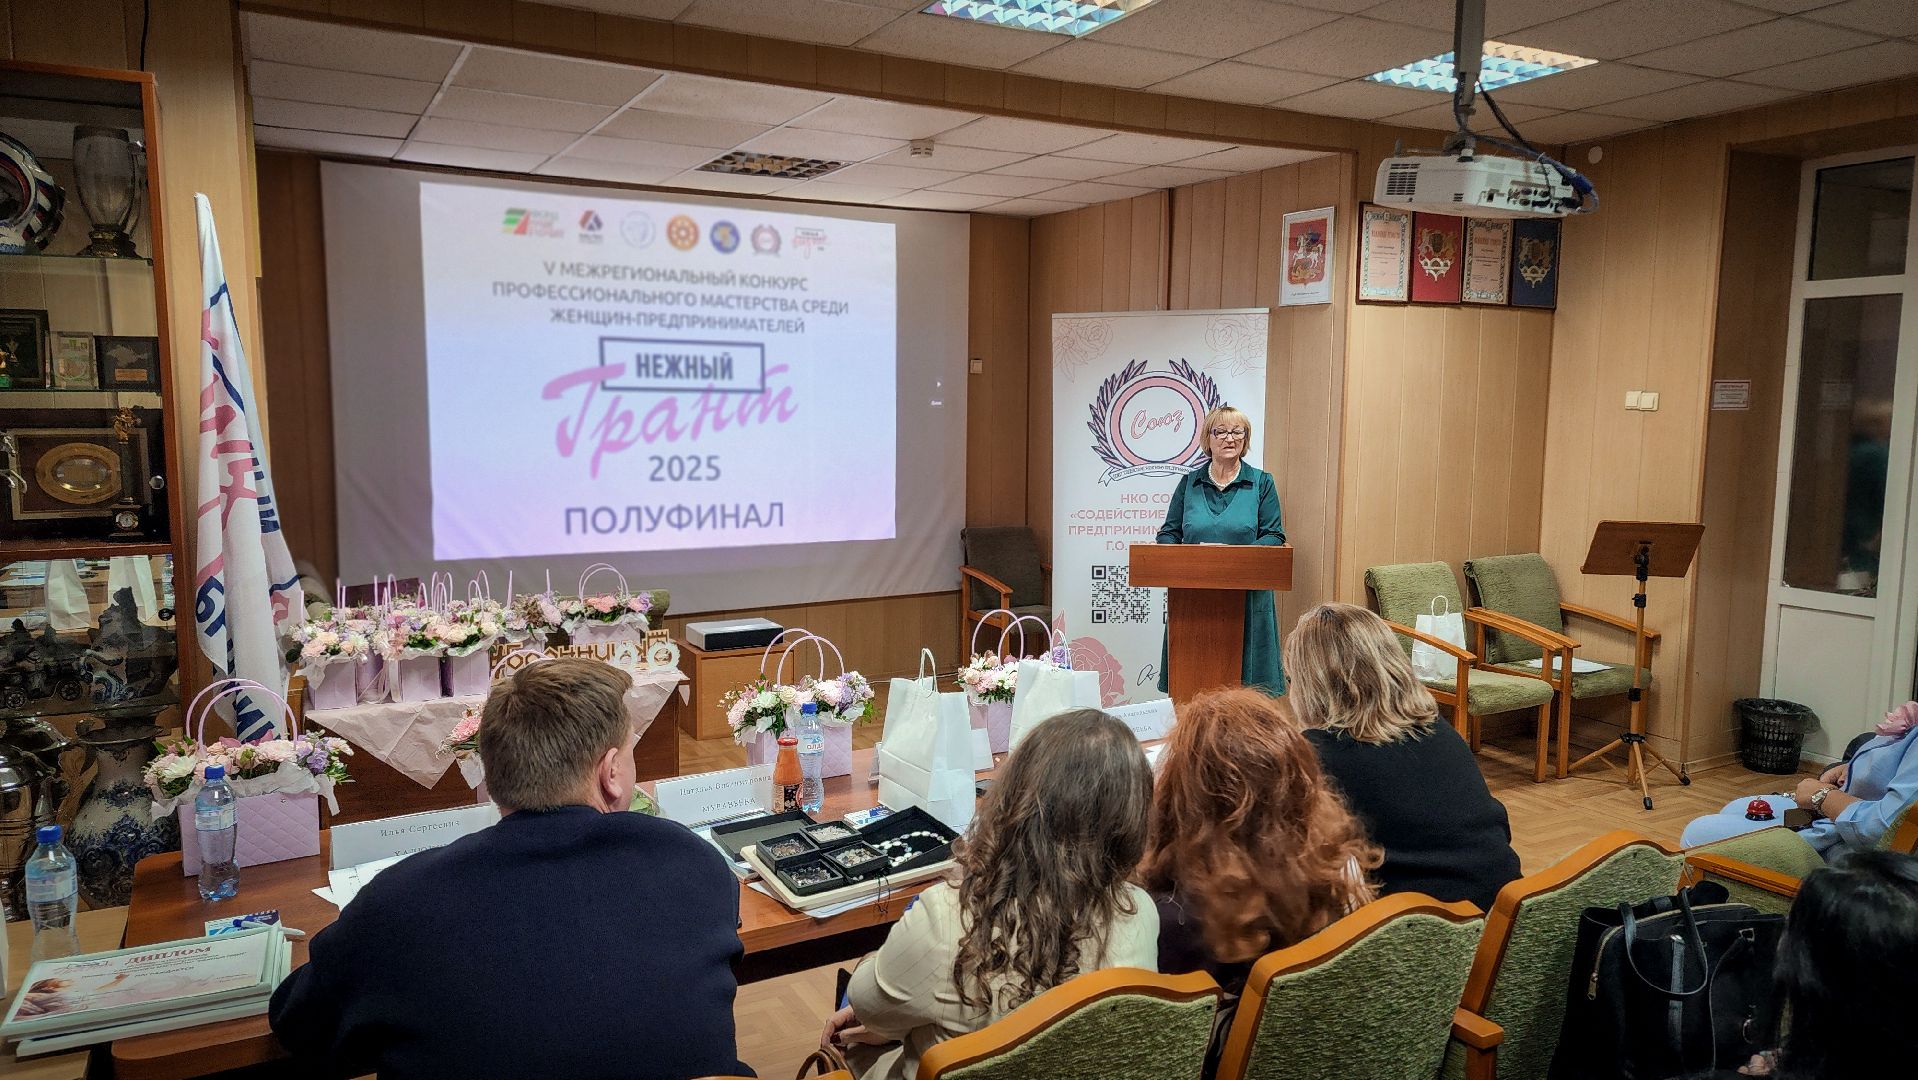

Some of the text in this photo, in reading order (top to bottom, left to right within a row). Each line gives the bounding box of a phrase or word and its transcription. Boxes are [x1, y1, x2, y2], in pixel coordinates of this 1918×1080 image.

[543, 261, 809, 292] V МЕЖРЕГИОНАЛЬНЫЙ КОНКУРС
[492, 281, 849, 316] ПРОФЕССИОНАЛЬНОГО МАСТЕРСТВА СРЕДИ
[550, 308, 805, 334] ЖЕНЩИН-ПРЕДПРИНИМАТЕЛЕЙ
[635, 352, 734, 381] НЕЖНЫЙ
[541, 363, 799, 480] Грант
[1130, 409, 1185, 440] Союз
[648, 455, 722, 482] 2025
[1120, 493, 1173, 504] НКО СО
[564, 501, 785, 536] ПОЛУФИНАЛ
[1070, 507, 1166, 520] «СОДЕЙСТВИЕ
[380, 828, 405, 837] Илья
[125, 946, 212, 965] ДИПЛОМ
